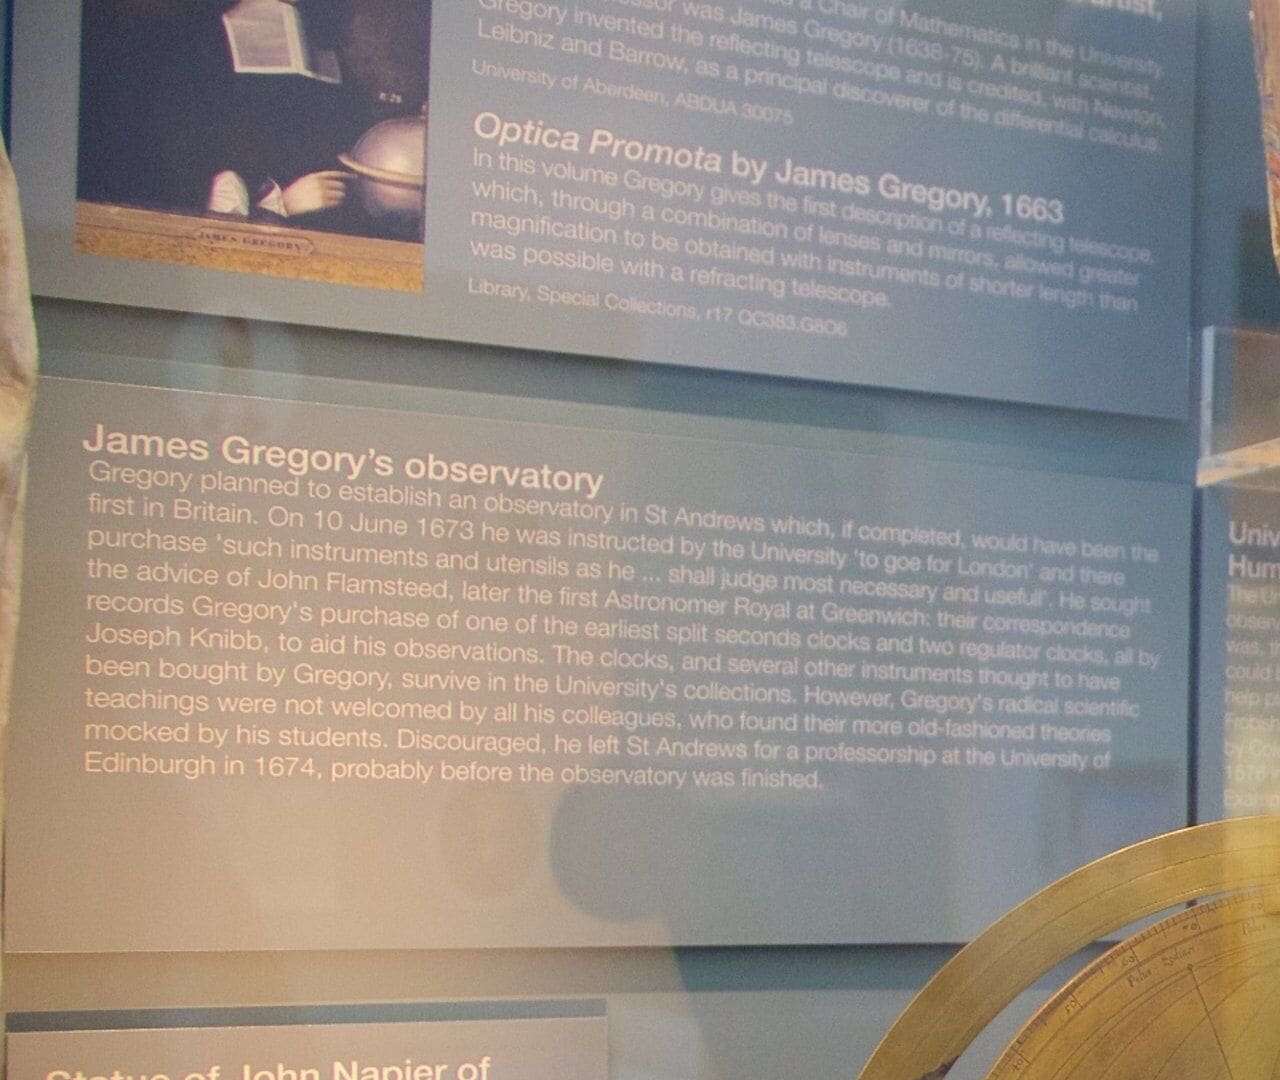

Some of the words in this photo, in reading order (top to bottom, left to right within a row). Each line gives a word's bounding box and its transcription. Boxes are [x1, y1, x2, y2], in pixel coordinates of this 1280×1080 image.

[477, 17, 555, 50] Leibniz
[560, 35, 602, 58] and
[695, 58, 720, 77] as
[725, 64, 739, 81] a
[474, 112, 580, 152] Optica
[589, 129, 722, 172] Promota
[731, 150, 768, 185] by
[775, 157, 870, 194] James
[878, 172, 992, 216] Gregory,
[1002, 192, 1065, 224] 1663
[471, 177, 544, 208] which,
[551, 186, 636, 220] through
[641, 203, 655, 220] a
[660, 205, 788, 237] combination
[793, 221, 814, 241] of
[818, 223, 881, 250] lenses
[886, 236, 924, 256] and
[469, 239, 516, 261] was
[523, 246, 614, 273] possible
[620, 255, 665, 279] with
[670, 264, 684, 281] a
[690, 265, 786, 298] refracting
[82, 423, 209, 460] James
[221, 435, 394, 479] Gregory's
[404, 451, 604, 500] observatory
[87, 490, 135, 518] first
[142, 494, 165, 520] in
[173, 496, 258, 525] Britain.
[267, 501, 305, 528] On
[315, 504, 344, 531] 10
[349, 507, 408, 535] June
[418, 511, 475, 539] 1673
[481, 515, 510, 541] he
[515, 523, 562, 544] was
[567, 521, 675, 552] instructed
[680, 529, 706, 560] by
[712, 531, 745, 557] the
[750, 534, 847, 570] University
[883, 549, 922, 573] goe
[926, 548, 951, 572] for
[1039, 558, 1075, 581] and
[1079, 560, 1126, 586] there
[88, 457, 193, 495] Gregory
[200, 467, 300, 497] planned
[308, 473, 332, 500] to
[338, 477, 442, 508] establish
[448, 489, 477, 510] an
[483, 487, 614, 526] observatory
[620, 497, 639, 522] in
[644, 499, 668, 524] St
[674, 501, 765, 532] Andrews
[770, 510, 835, 540] which,
[841, 514, 854, 538] if
[971, 528, 1028, 552] would
[1032, 530, 1077, 556] have
[1081, 534, 1126, 560] been
[1131, 538, 1160, 562] the
[84, 746, 216, 780] Edinburgh
[224, 750, 245, 775] in
[257, 751, 322, 780] 1674,
[331, 754, 434, 785] probably
[440, 755, 513, 781] before
[519, 757, 555, 782] the
[560, 759, 687, 791] observatory
[692, 767, 735, 786] was
[741, 763, 823, 788] finished.
